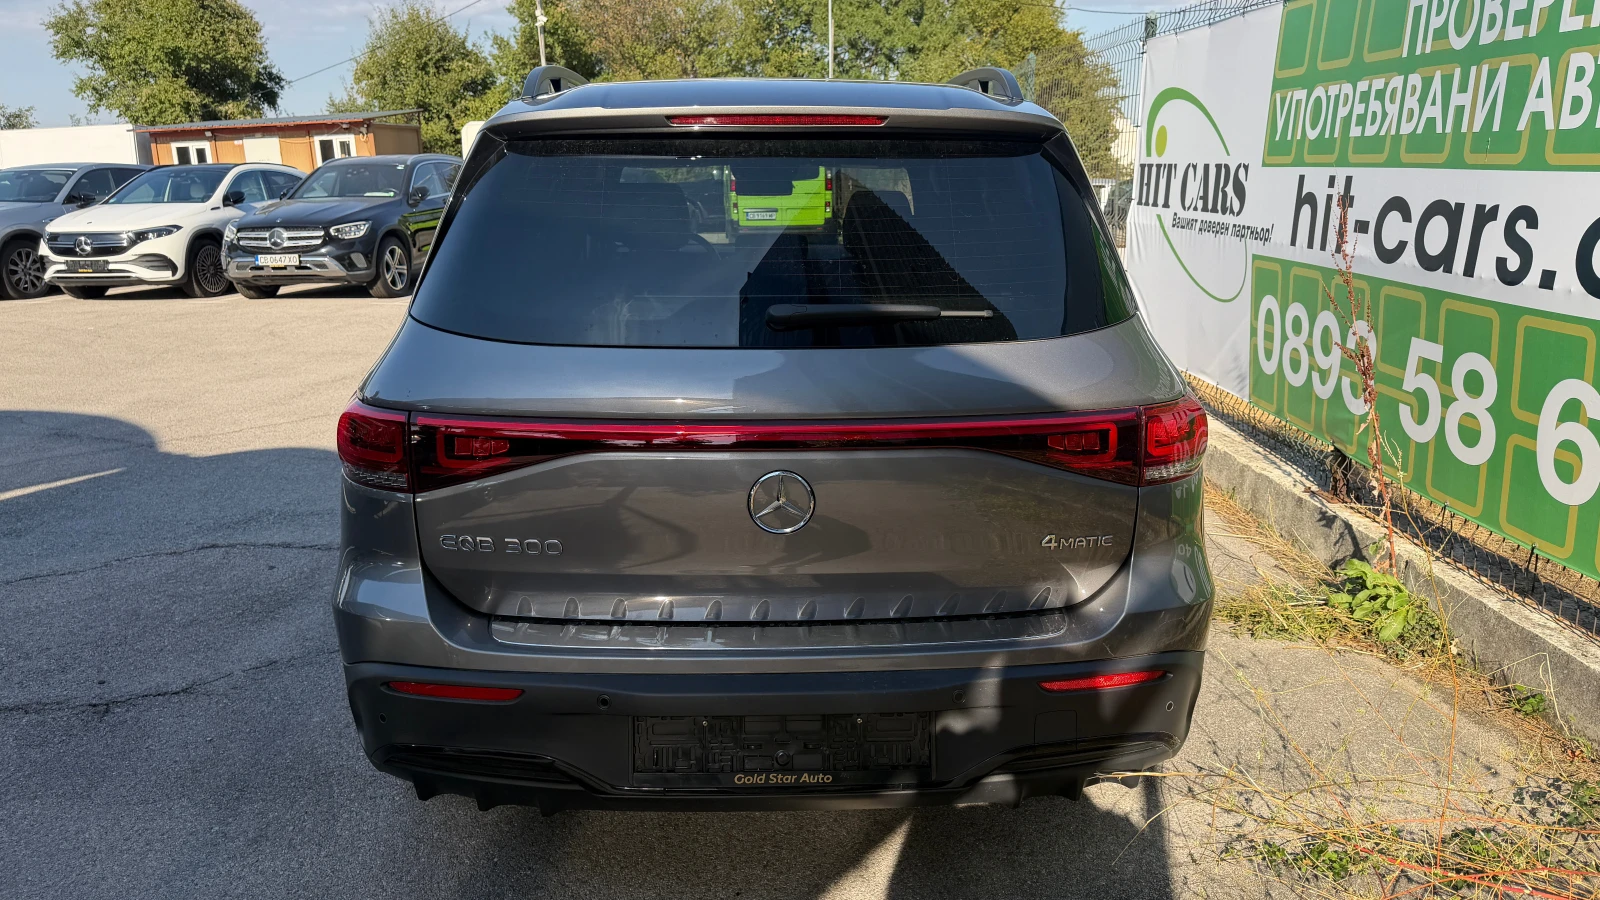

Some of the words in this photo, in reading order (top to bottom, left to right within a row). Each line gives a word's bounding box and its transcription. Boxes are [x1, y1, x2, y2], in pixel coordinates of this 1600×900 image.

[1275, 61, 1509, 141] УПОТРЕБЯВАНИ
[1516, 51, 1600, 131] АВ
[1136, 163, 1177, 208] HIT
[1180, 162, 1249, 217] CARS
[1171, 212, 1198, 228] Вашият
[1198, 219, 1230, 238] доверен
[1230, 223, 1274, 246] партньор!
[1399, 336, 1498, 466] 58
[439, 534, 495, 552] EQB
[504, 538, 563, 555] 300
[1041, 534, 1113, 550] 4MATIC
[734, 773, 766, 784] Gold
[768, 773, 797, 784] Star
[799, 772, 833, 783] Auto
